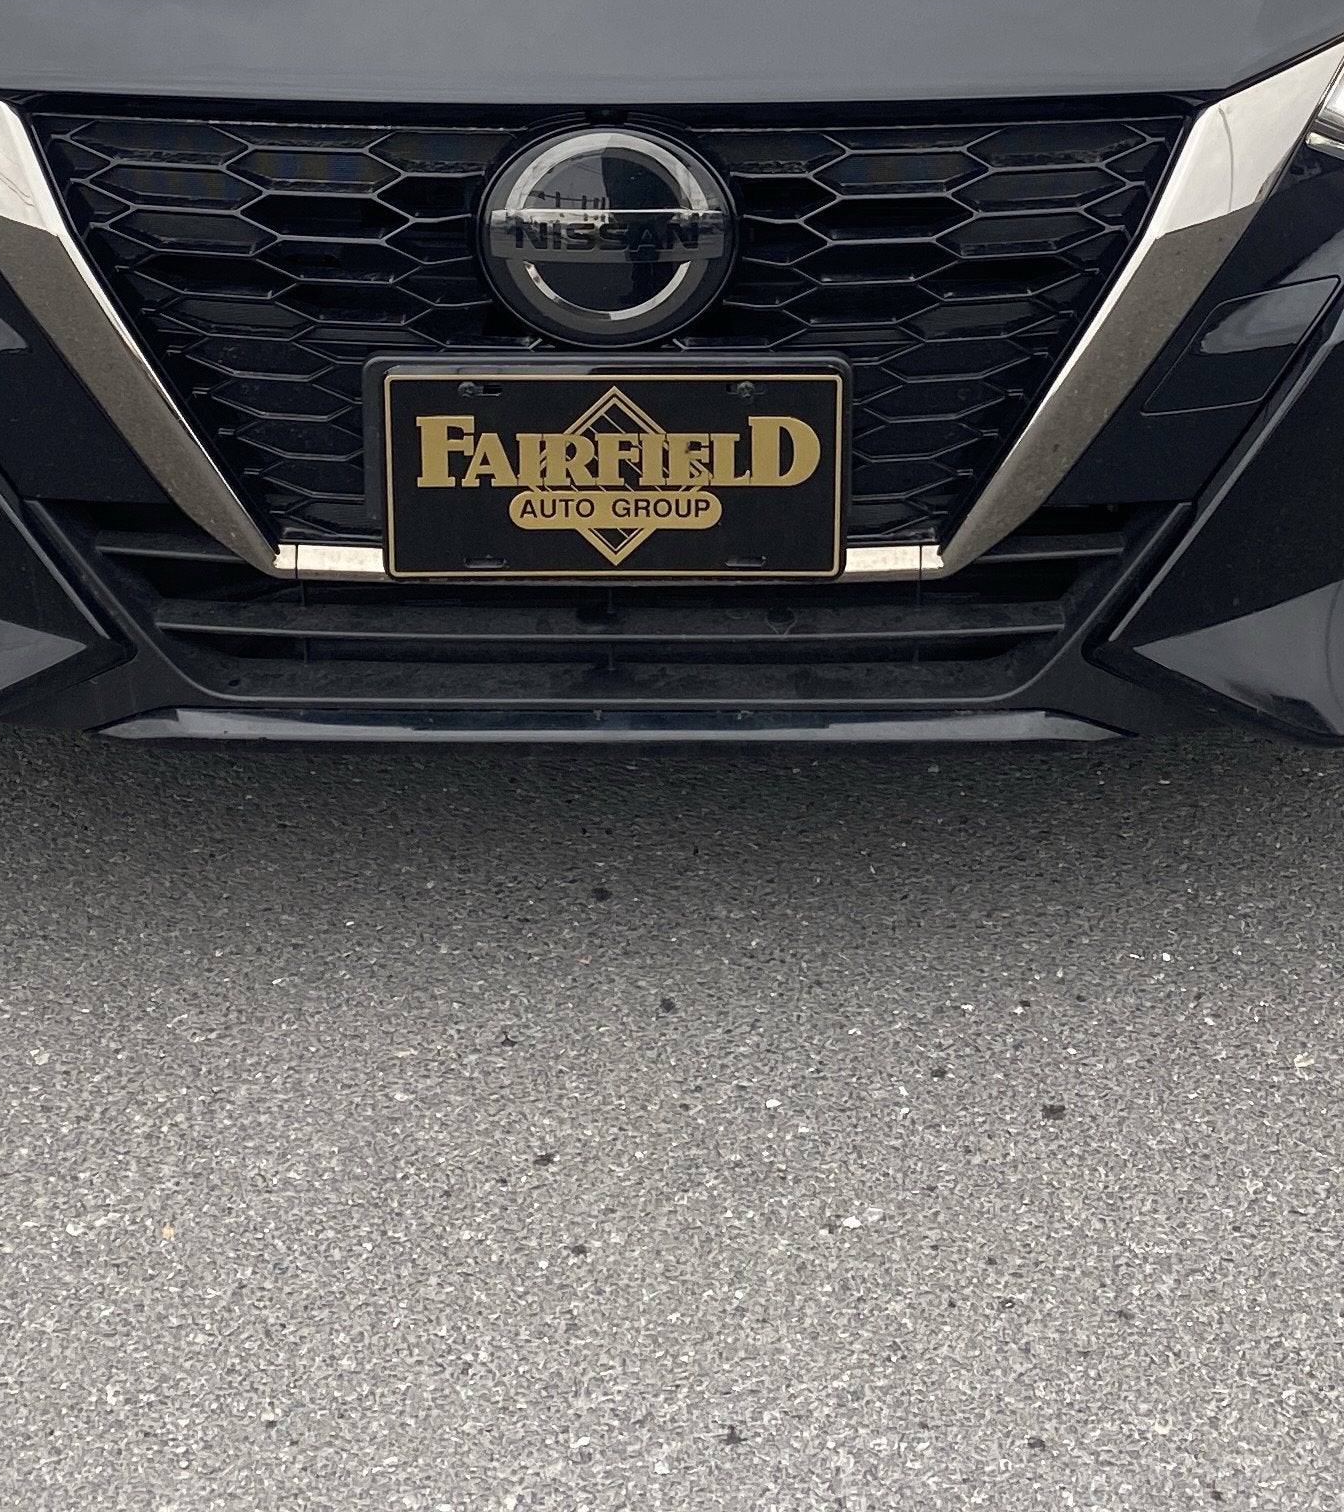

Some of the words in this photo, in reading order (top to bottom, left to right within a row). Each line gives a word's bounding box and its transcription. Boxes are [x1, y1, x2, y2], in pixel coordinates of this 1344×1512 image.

[515, 222, 700, 251] NISSAN
[416, 415, 821, 487] FAIRFIELD
[519, 498, 595, 518] AUTO
[611, 498, 710, 518] GROUP
